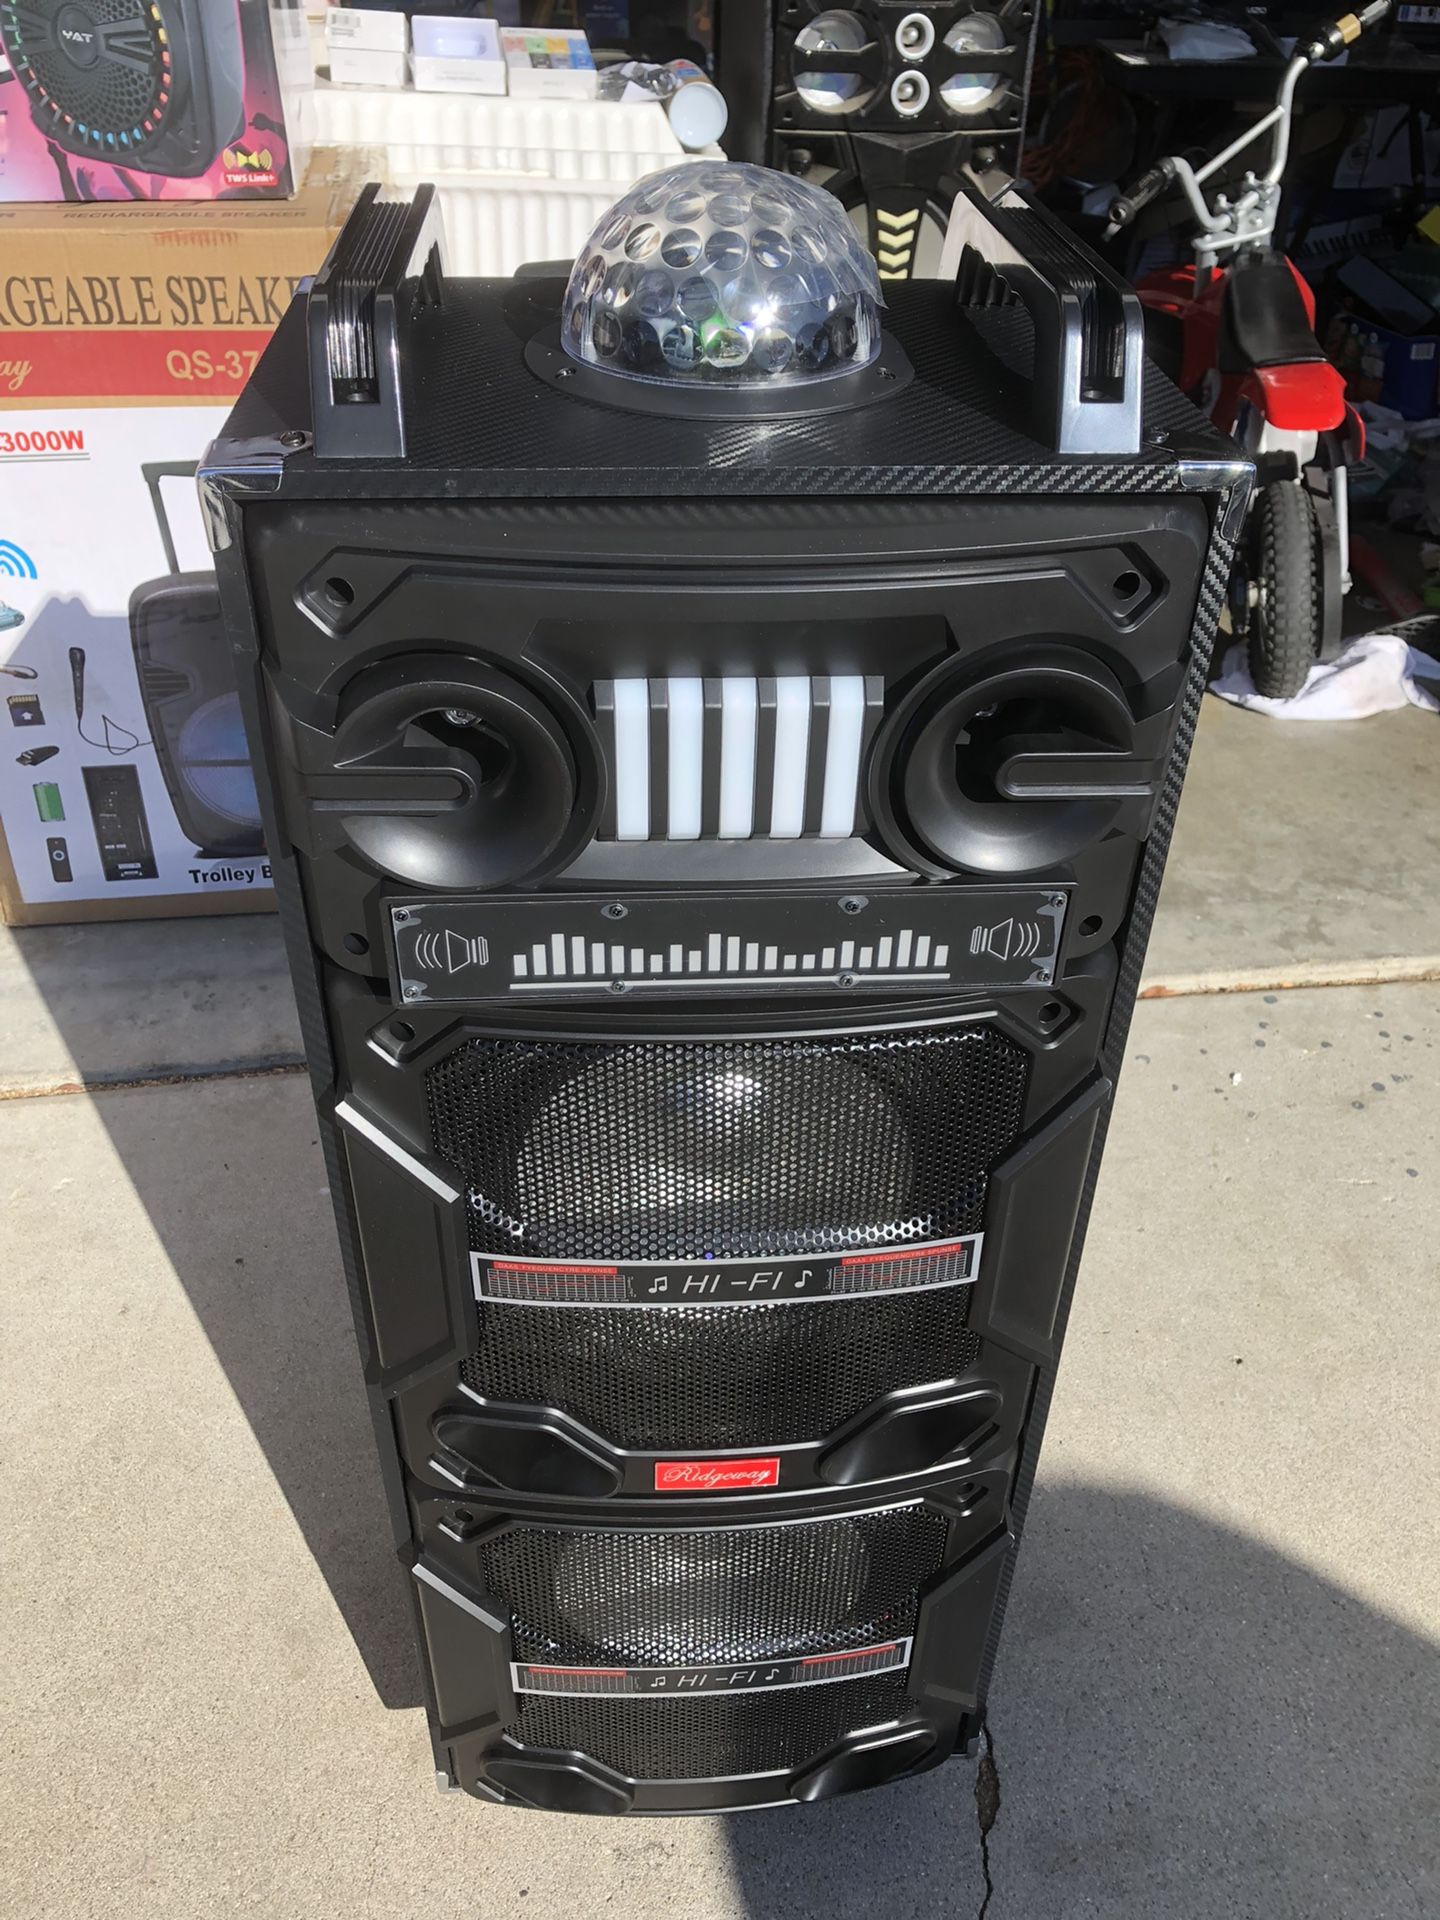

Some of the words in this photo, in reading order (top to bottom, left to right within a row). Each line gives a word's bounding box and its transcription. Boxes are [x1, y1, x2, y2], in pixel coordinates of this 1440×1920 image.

[226, 173, 248, 183] TWS
[63, 211, 215, 219] RECHARGEABLE
[188, 867, 255, 884] Trolley
[663, 1464, 771, 1488] Ridgeway
